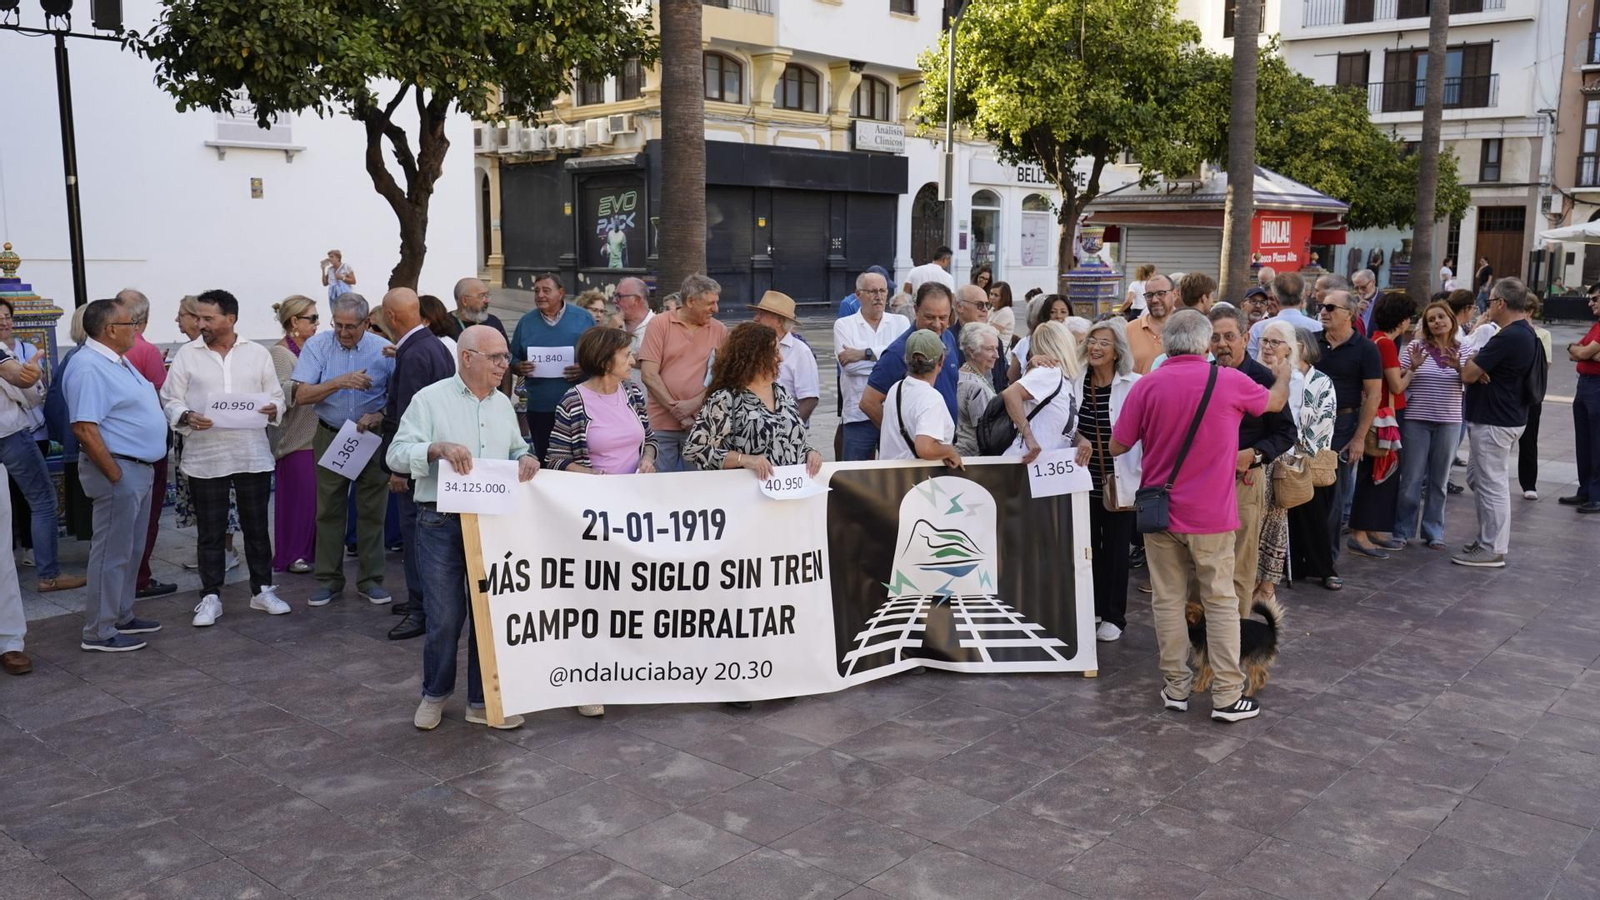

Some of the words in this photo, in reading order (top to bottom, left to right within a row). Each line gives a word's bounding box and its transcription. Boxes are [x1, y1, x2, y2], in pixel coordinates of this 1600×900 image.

[875, 124, 903, 136] Análisis
[598, 191, 637, 216] EVO
[1262, 220, 1290, 244] ¡HOLA!
[531, 354, 563, 363] 21.840
[211, 401, 255, 411] 40.950
[332, 437, 360, 470] 1.365
[1033, 460, 1074, 478] 1.365
[444, 481, 506, 494] 34.125.000
[765, 476, 803, 492] 40.950
[582, 508, 726, 542] 21-01-1919
[486, 551, 531, 596] MÁS
[541, 557, 575, 589] DE
[585, 560, 620, 591] UN
[631, 561, 710, 592] SIGLO
[720, 557, 762, 590] SIN
[770, 549, 823, 587] TREN
[506, 608, 599, 647] CAMPO
[610, 610, 644, 639] DE
[653, 604, 796, 639] GIBRALTAR
[549, 660, 708, 687] @ndaluciabay
[714, 660, 773, 681] 20.30
